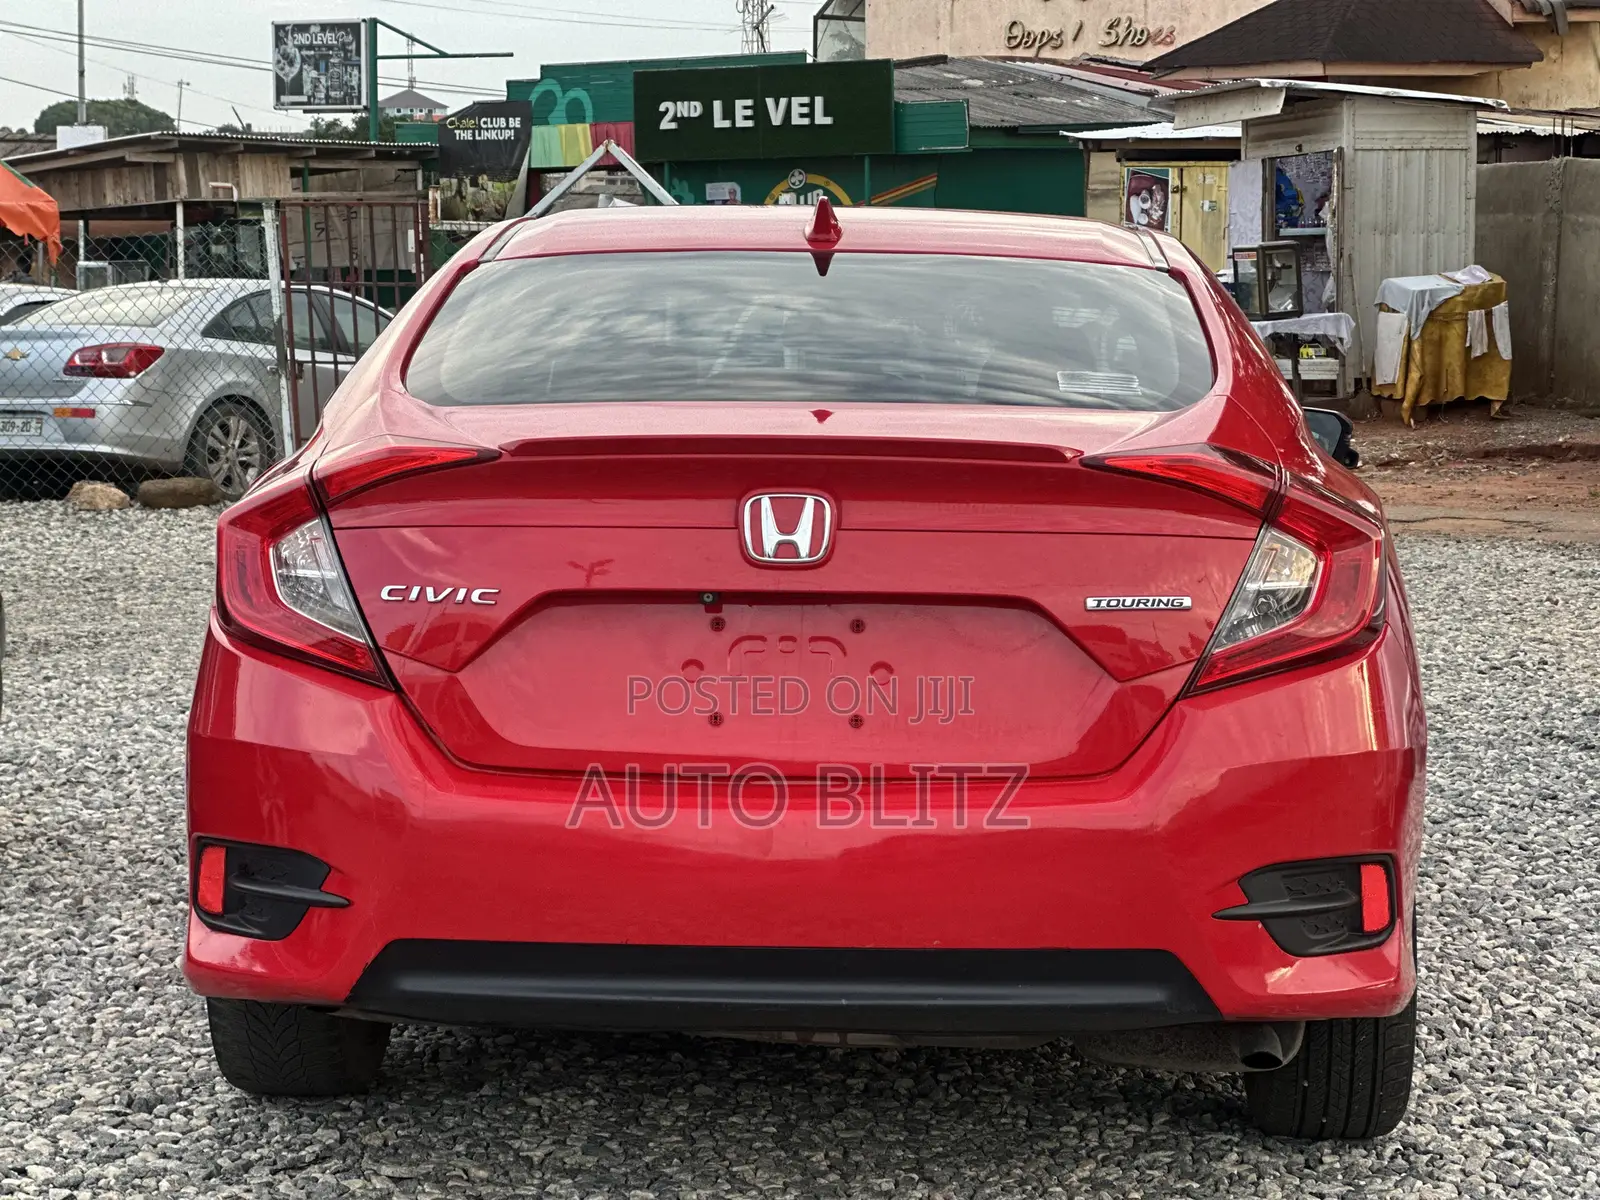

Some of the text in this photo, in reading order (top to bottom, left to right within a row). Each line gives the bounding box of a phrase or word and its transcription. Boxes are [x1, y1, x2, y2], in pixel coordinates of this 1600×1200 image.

[293, 33, 311, 44] 2ND
[312, 29, 337, 44] LEVEL
[1099, 16, 1176, 47] Shoes
[481, 117, 506, 129] CLUB
[508, 117, 522, 128] BE
[659, 101, 703, 130] 2ND
[454, 129, 515, 140] THE LINKUP!
[380, 585, 500, 605] CIVIC
[1091, 598, 1185, 608] TOURING
